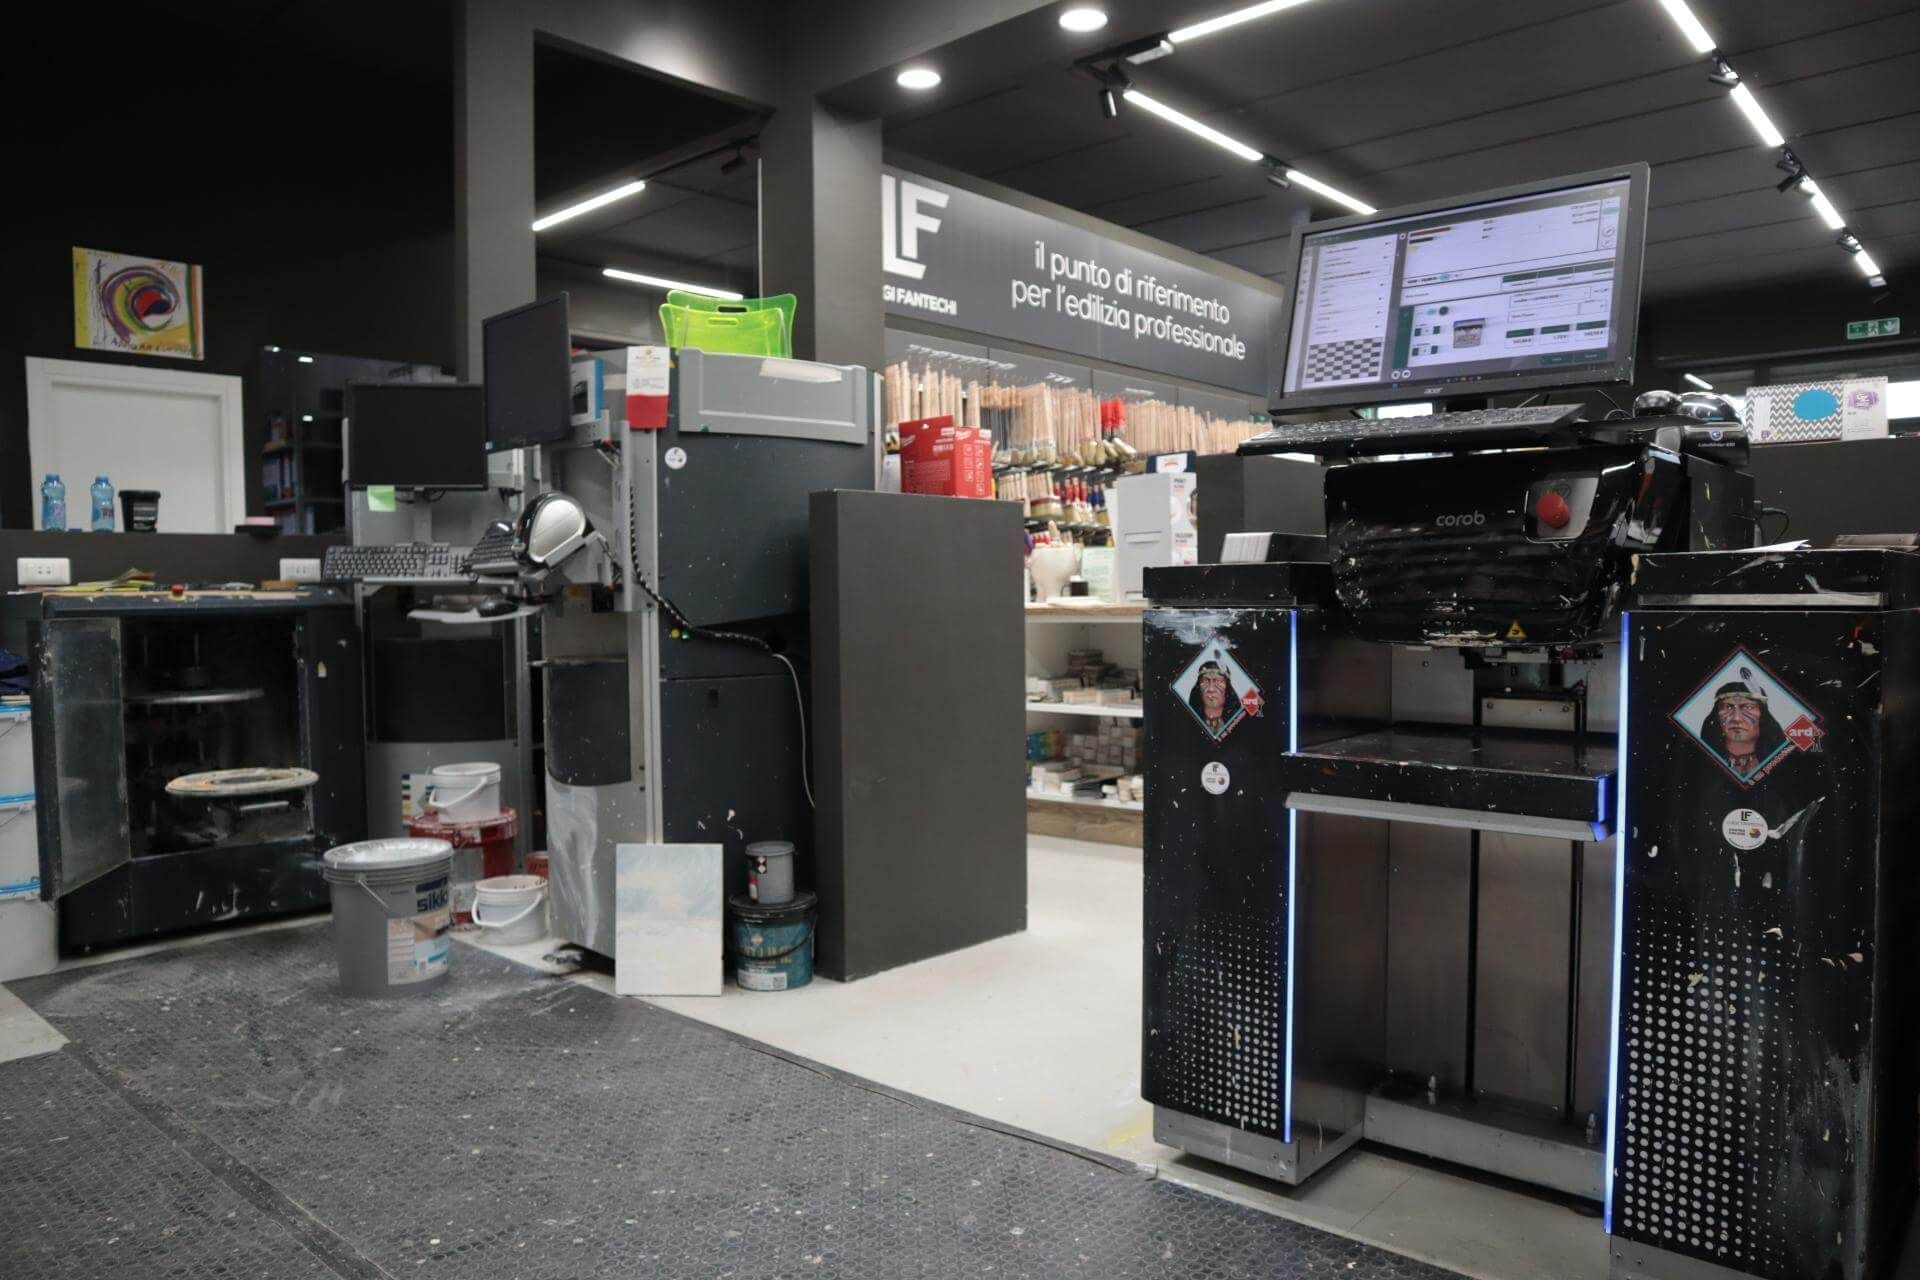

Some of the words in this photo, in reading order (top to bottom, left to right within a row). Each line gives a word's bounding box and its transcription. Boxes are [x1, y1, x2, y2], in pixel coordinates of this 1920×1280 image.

[881, 174, 950, 280] LF
[1034, 240, 1045, 270] il
[1050, 250, 1111, 290] punto
[1115, 267, 1133, 296] di
[1136, 274, 1230, 325] riferimento
[896, 287, 957, 316] FANTECHI
[1011, 278, 1052, 309] per
[1056, 283, 1130, 330] l'edilizia
[1134, 312, 1246, 361] professionale
[1436, 510, 1486, 527] corob
[1789, 727, 1813, 737] ard
[1740, 810, 1752, 821] LF
